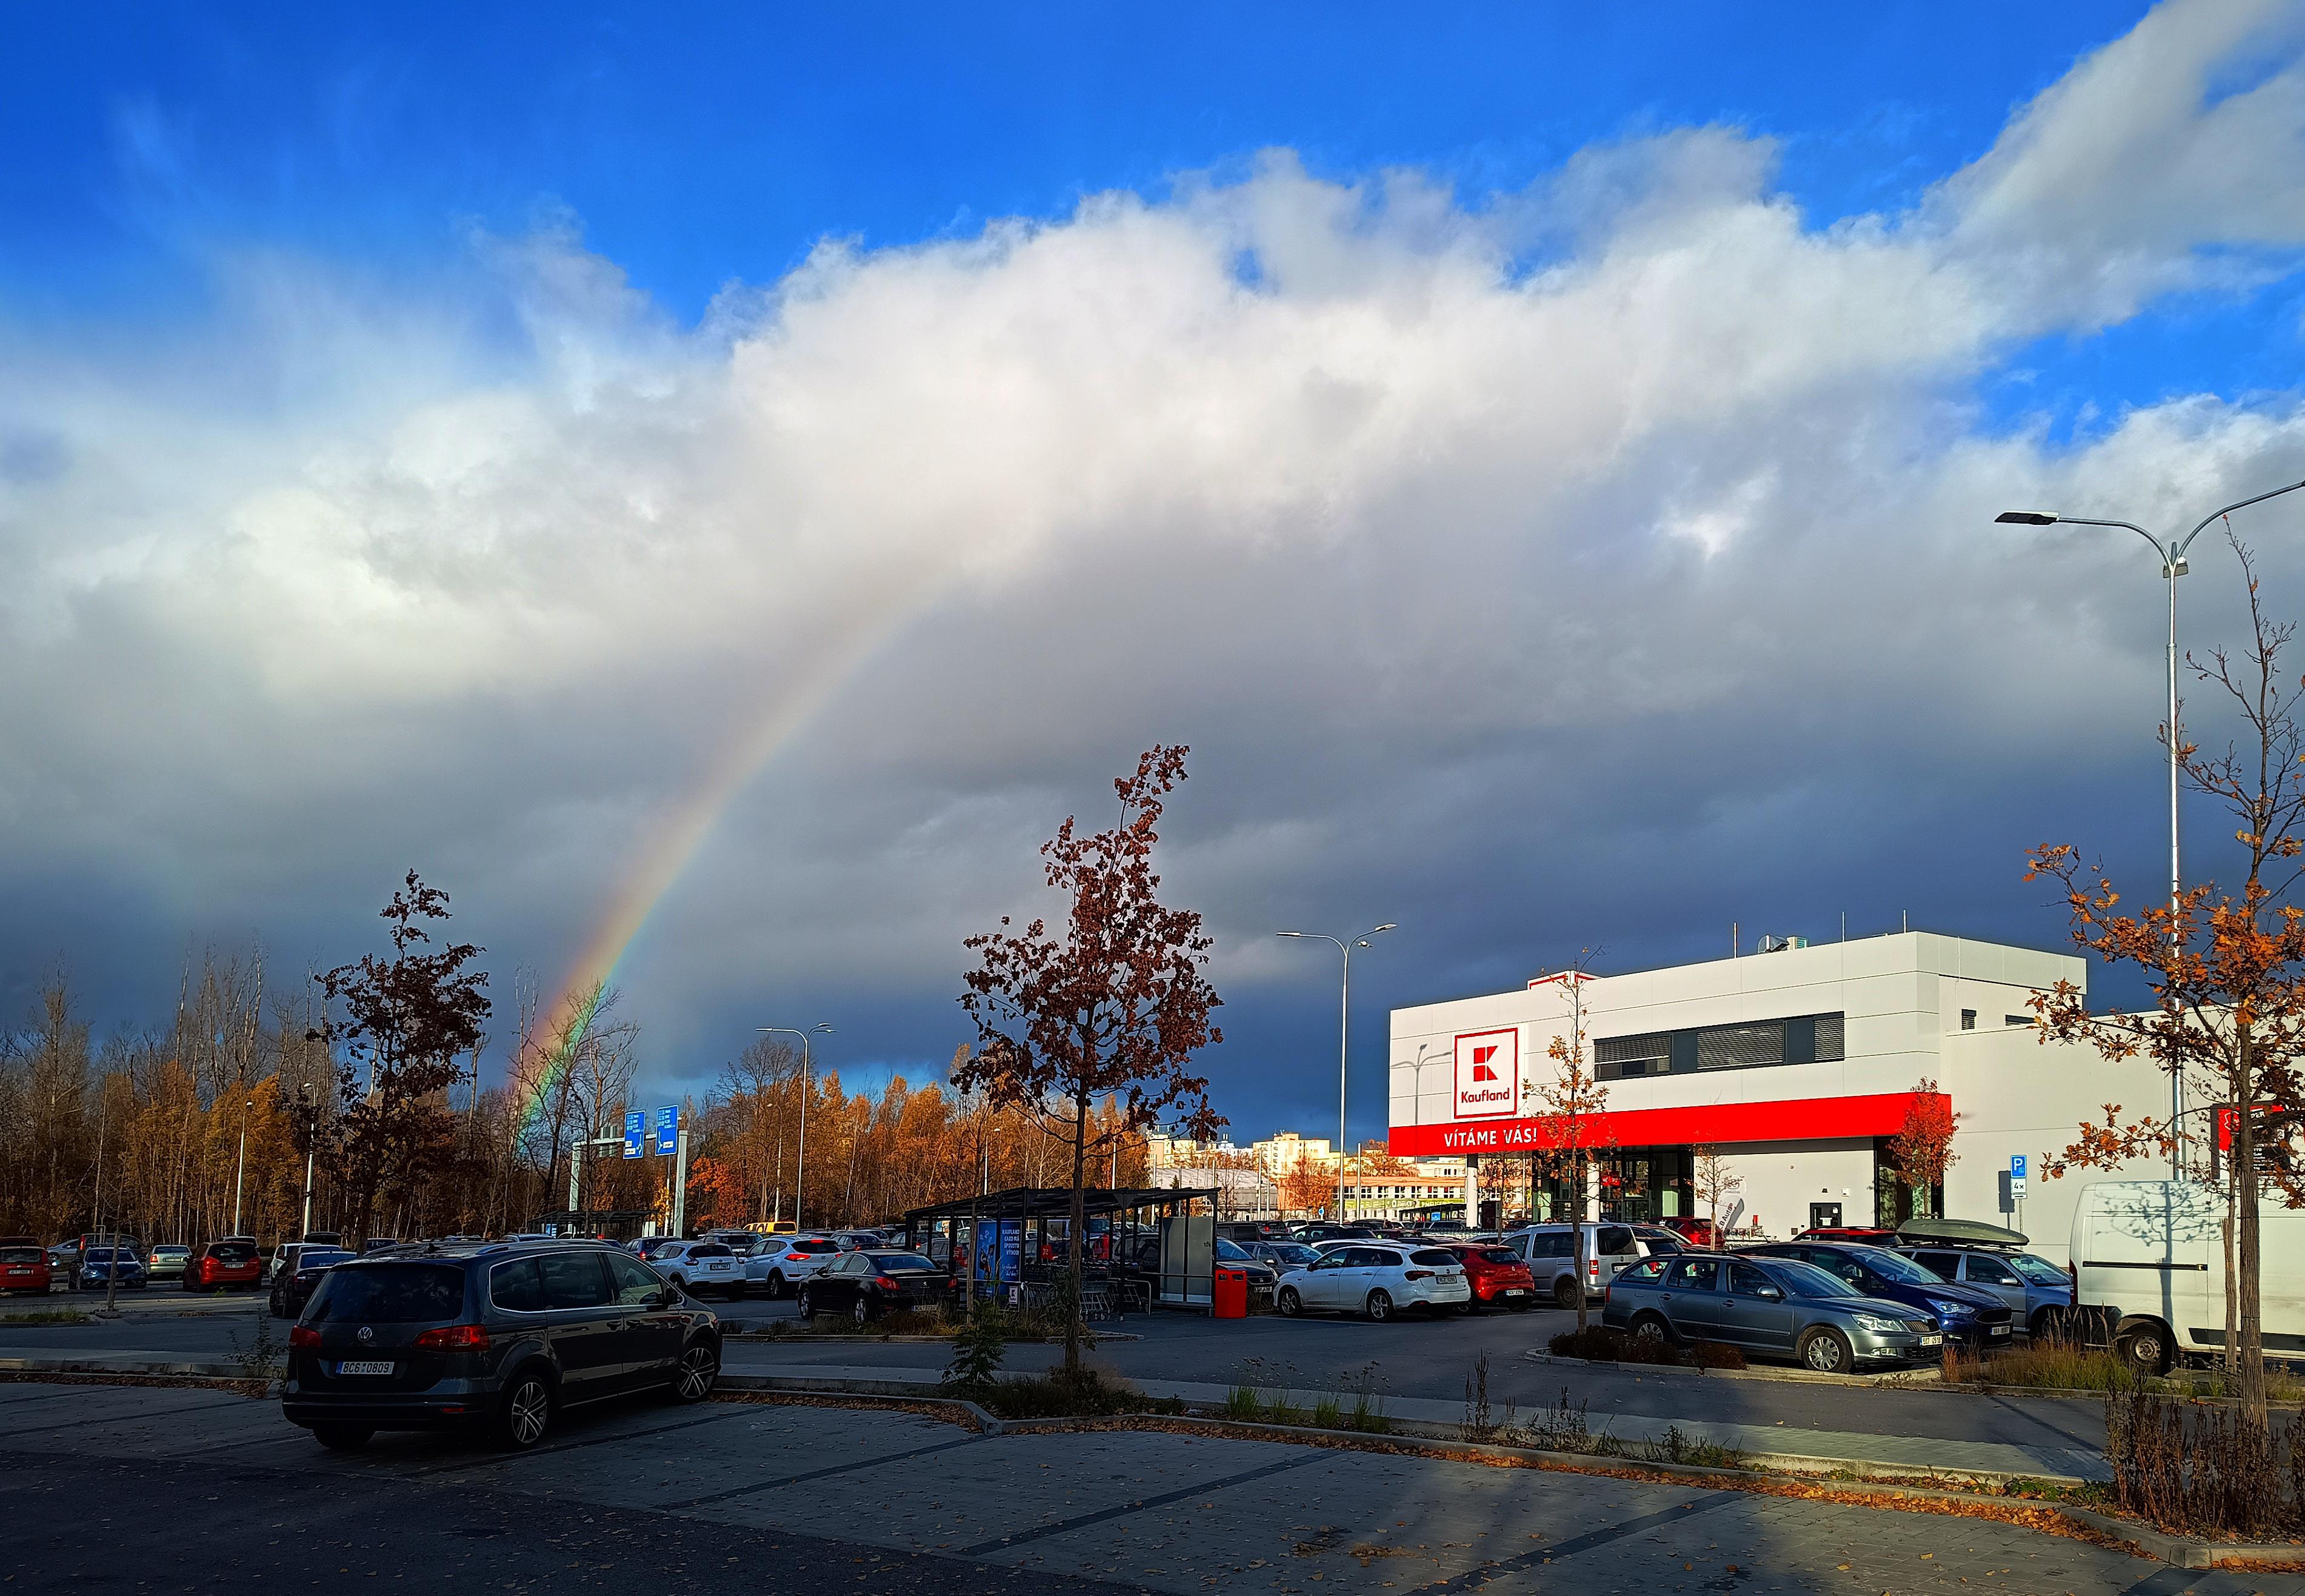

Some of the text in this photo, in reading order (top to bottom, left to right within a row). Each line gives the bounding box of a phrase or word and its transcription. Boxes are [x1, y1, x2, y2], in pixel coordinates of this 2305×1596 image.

[1461, 1087, 1510, 1103] Kaufland
[1444, 1125, 1537, 1147] VÍTÁME VÁS!
[343, 1363, 390, 1373] 8C6 0809
